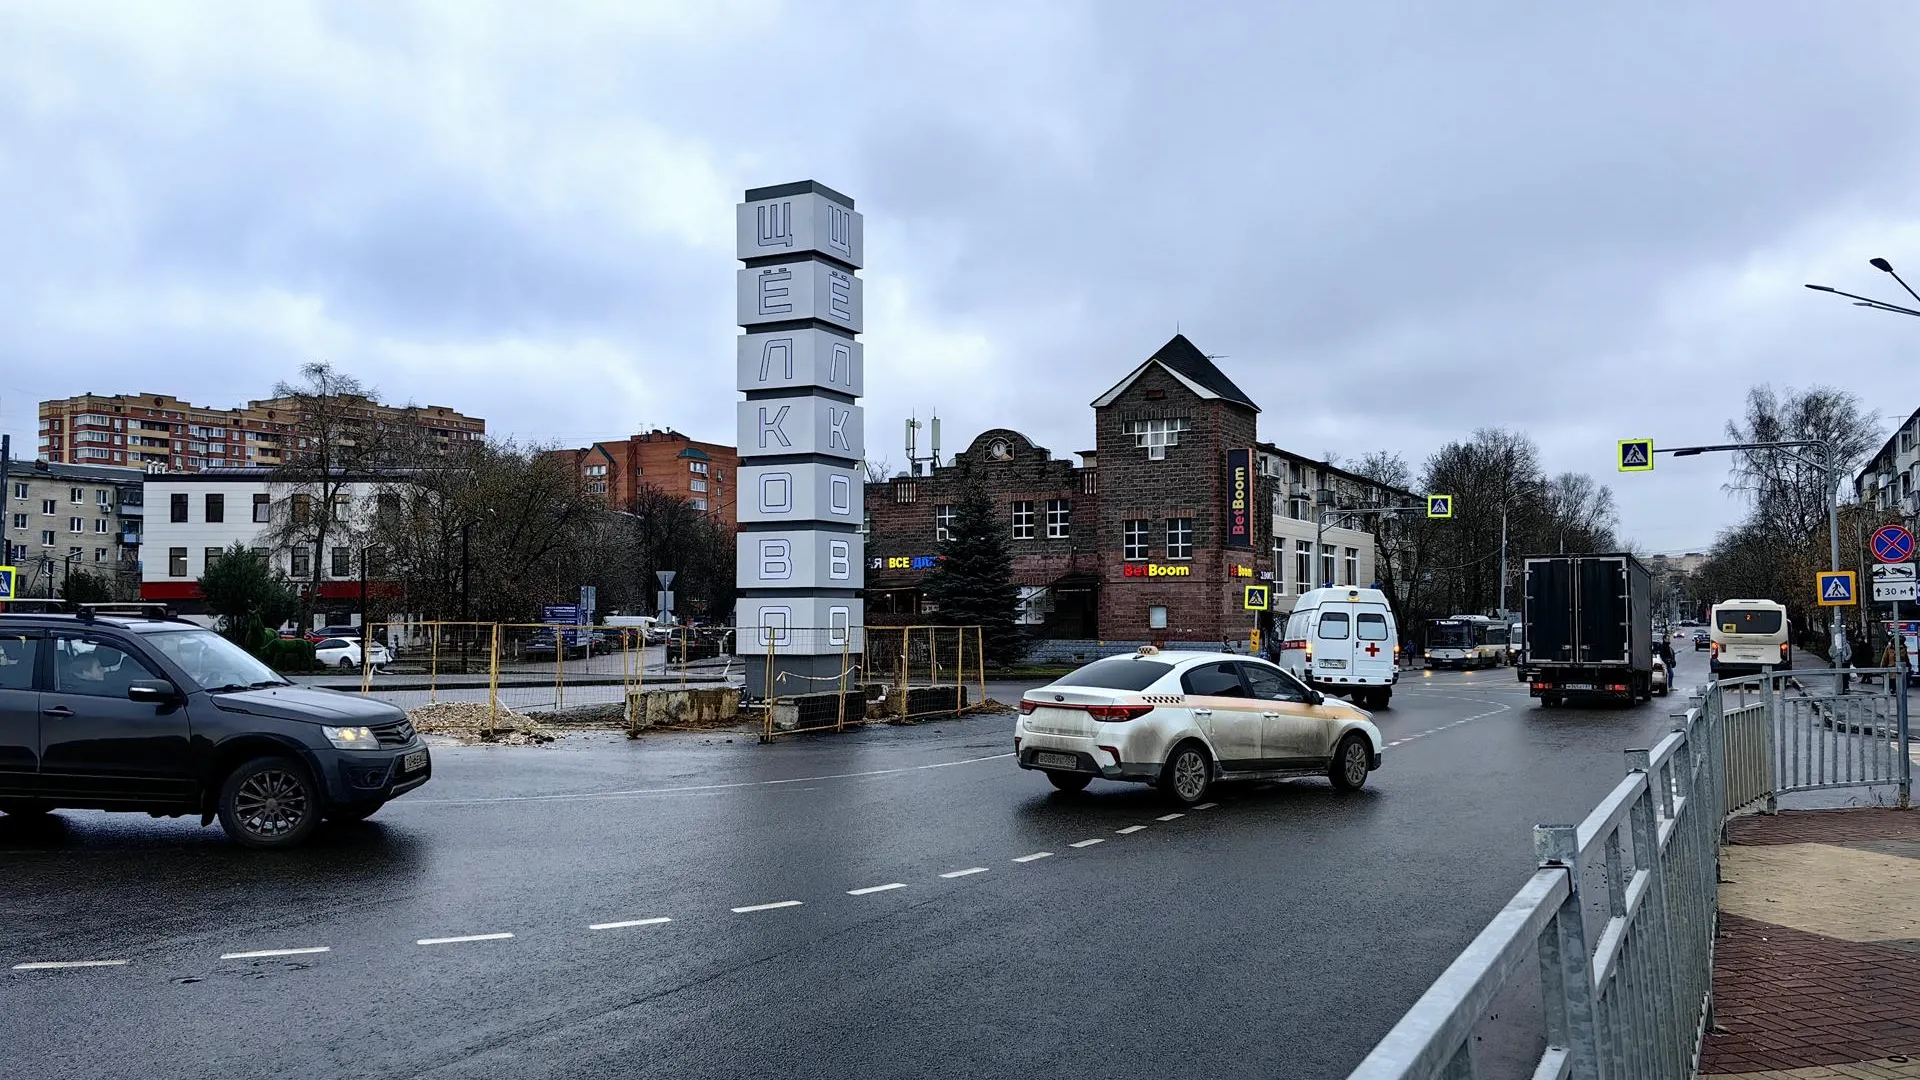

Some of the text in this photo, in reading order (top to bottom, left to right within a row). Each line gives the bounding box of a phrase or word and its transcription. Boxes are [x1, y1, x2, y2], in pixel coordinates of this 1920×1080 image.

[757, 201, 793, 647] ЩЁЛКОВО
[828, 204, 851, 647] ЩЁЛКОВО
[1231, 466, 1245, 535] BetBoom
[888, 556, 910, 569] ВСЕ
[1123, 563, 1190, 577] BetBoom
[1884, 587, 1897, 596] 30
